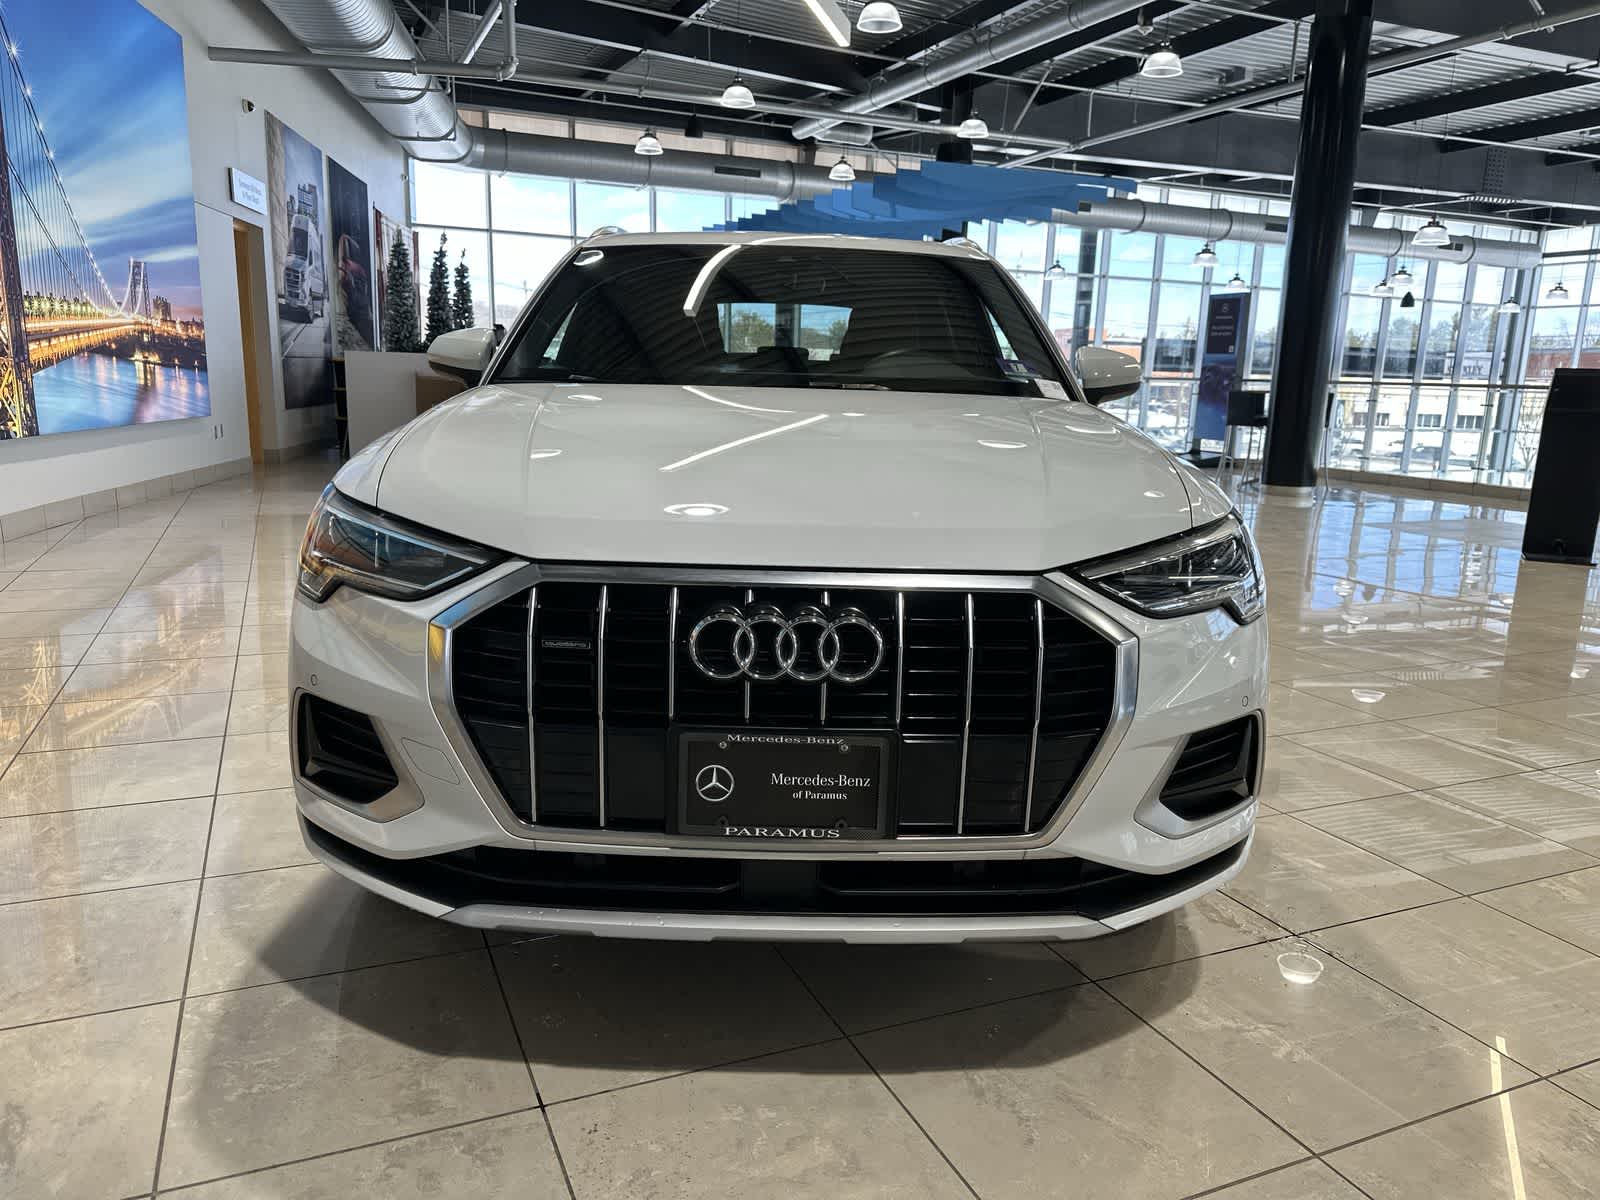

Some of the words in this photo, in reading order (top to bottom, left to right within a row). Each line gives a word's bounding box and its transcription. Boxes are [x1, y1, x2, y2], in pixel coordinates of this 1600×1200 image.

[727, 734, 844, 745] Mercedes-Benz
[770, 773, 871, 787] Mercedes-Benz
[792, 790, 803, 799] of
[805, 790, 848, 800] Paramus
[724, 827, 840, 838] PARAMUS
